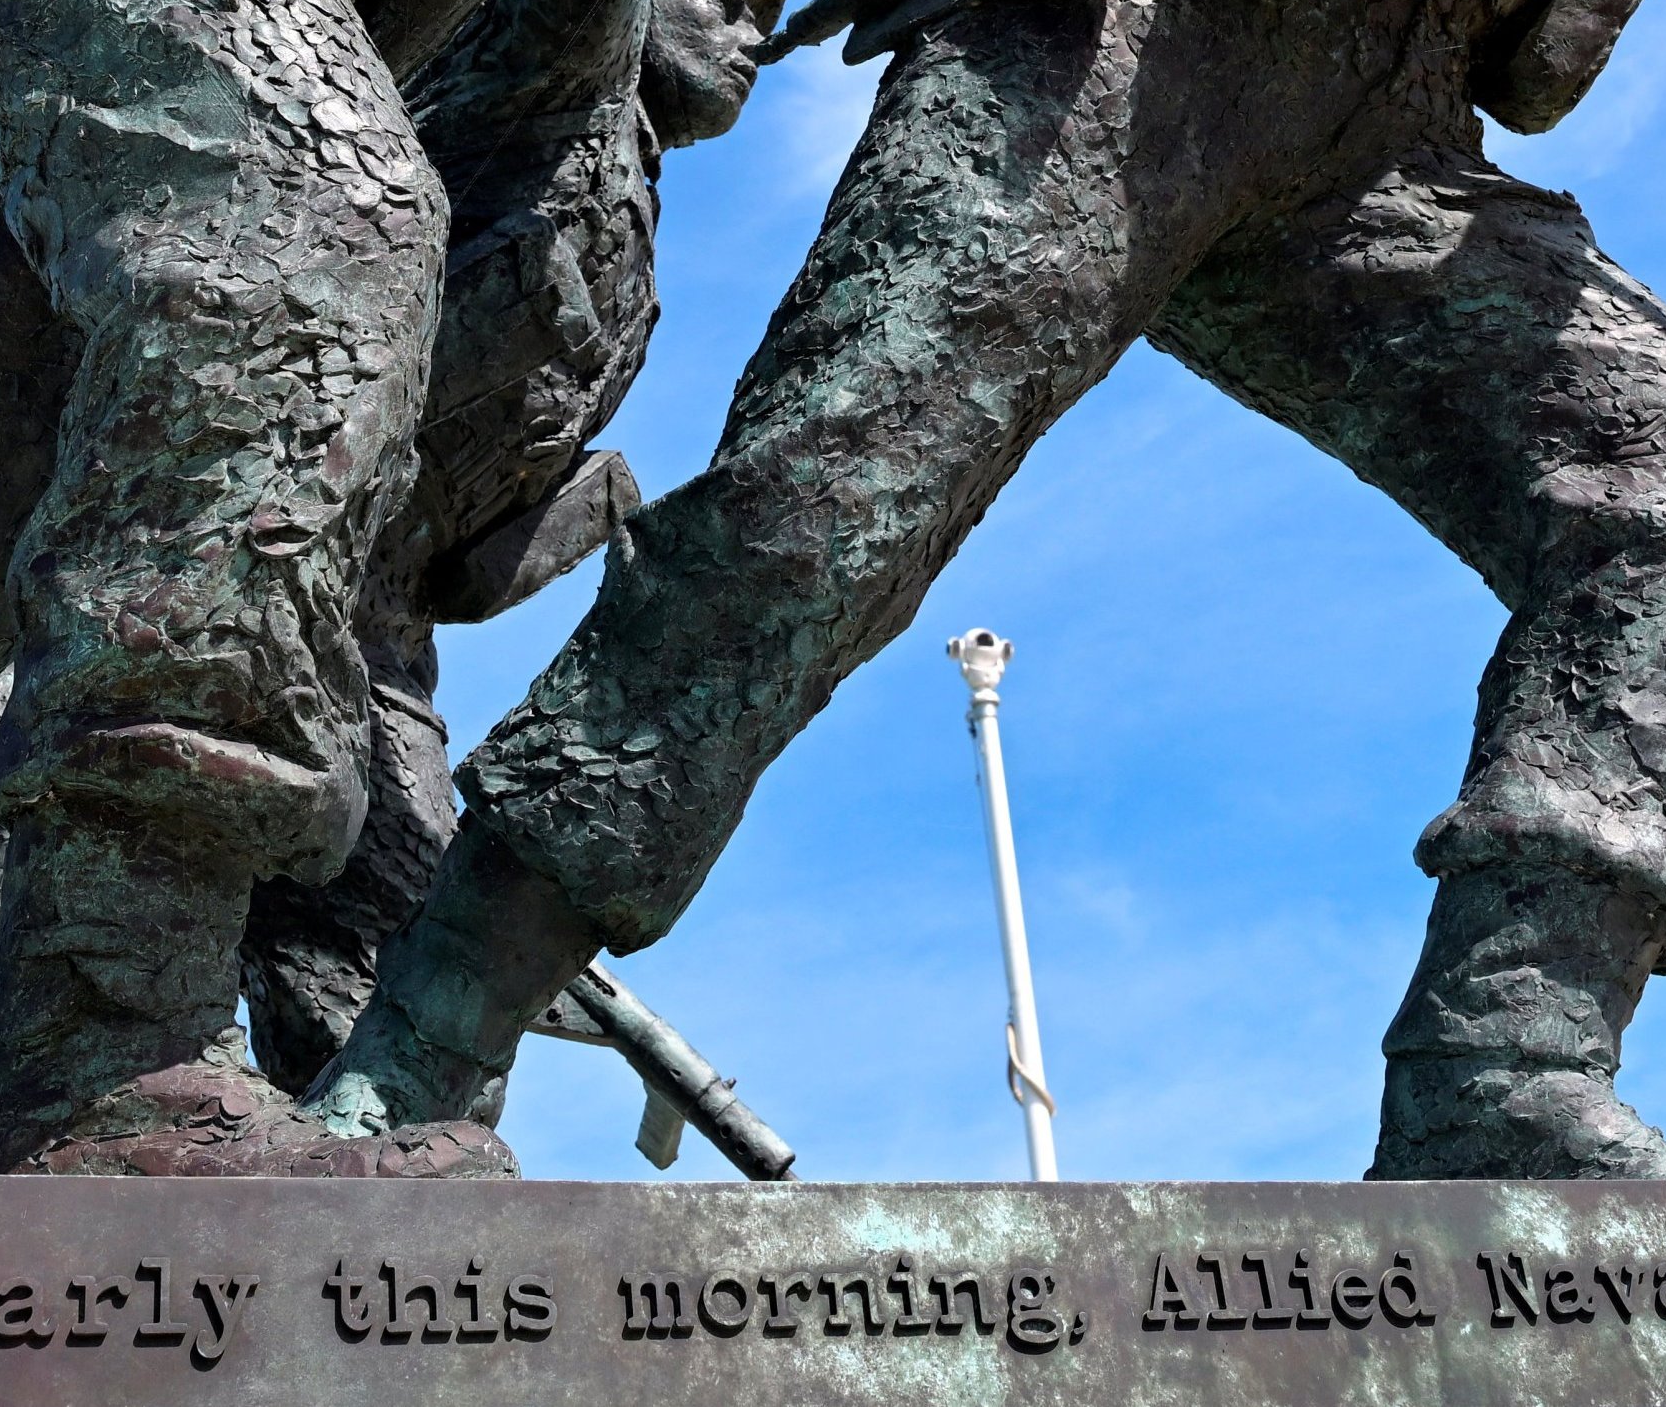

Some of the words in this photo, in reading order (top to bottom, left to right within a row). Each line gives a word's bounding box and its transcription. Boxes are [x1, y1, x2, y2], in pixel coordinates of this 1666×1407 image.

[327, 1255, 557, 1342] this
[619, 1255, 1089, 1351] morning,
[1143, 1248, 1436, 1327] Allied
